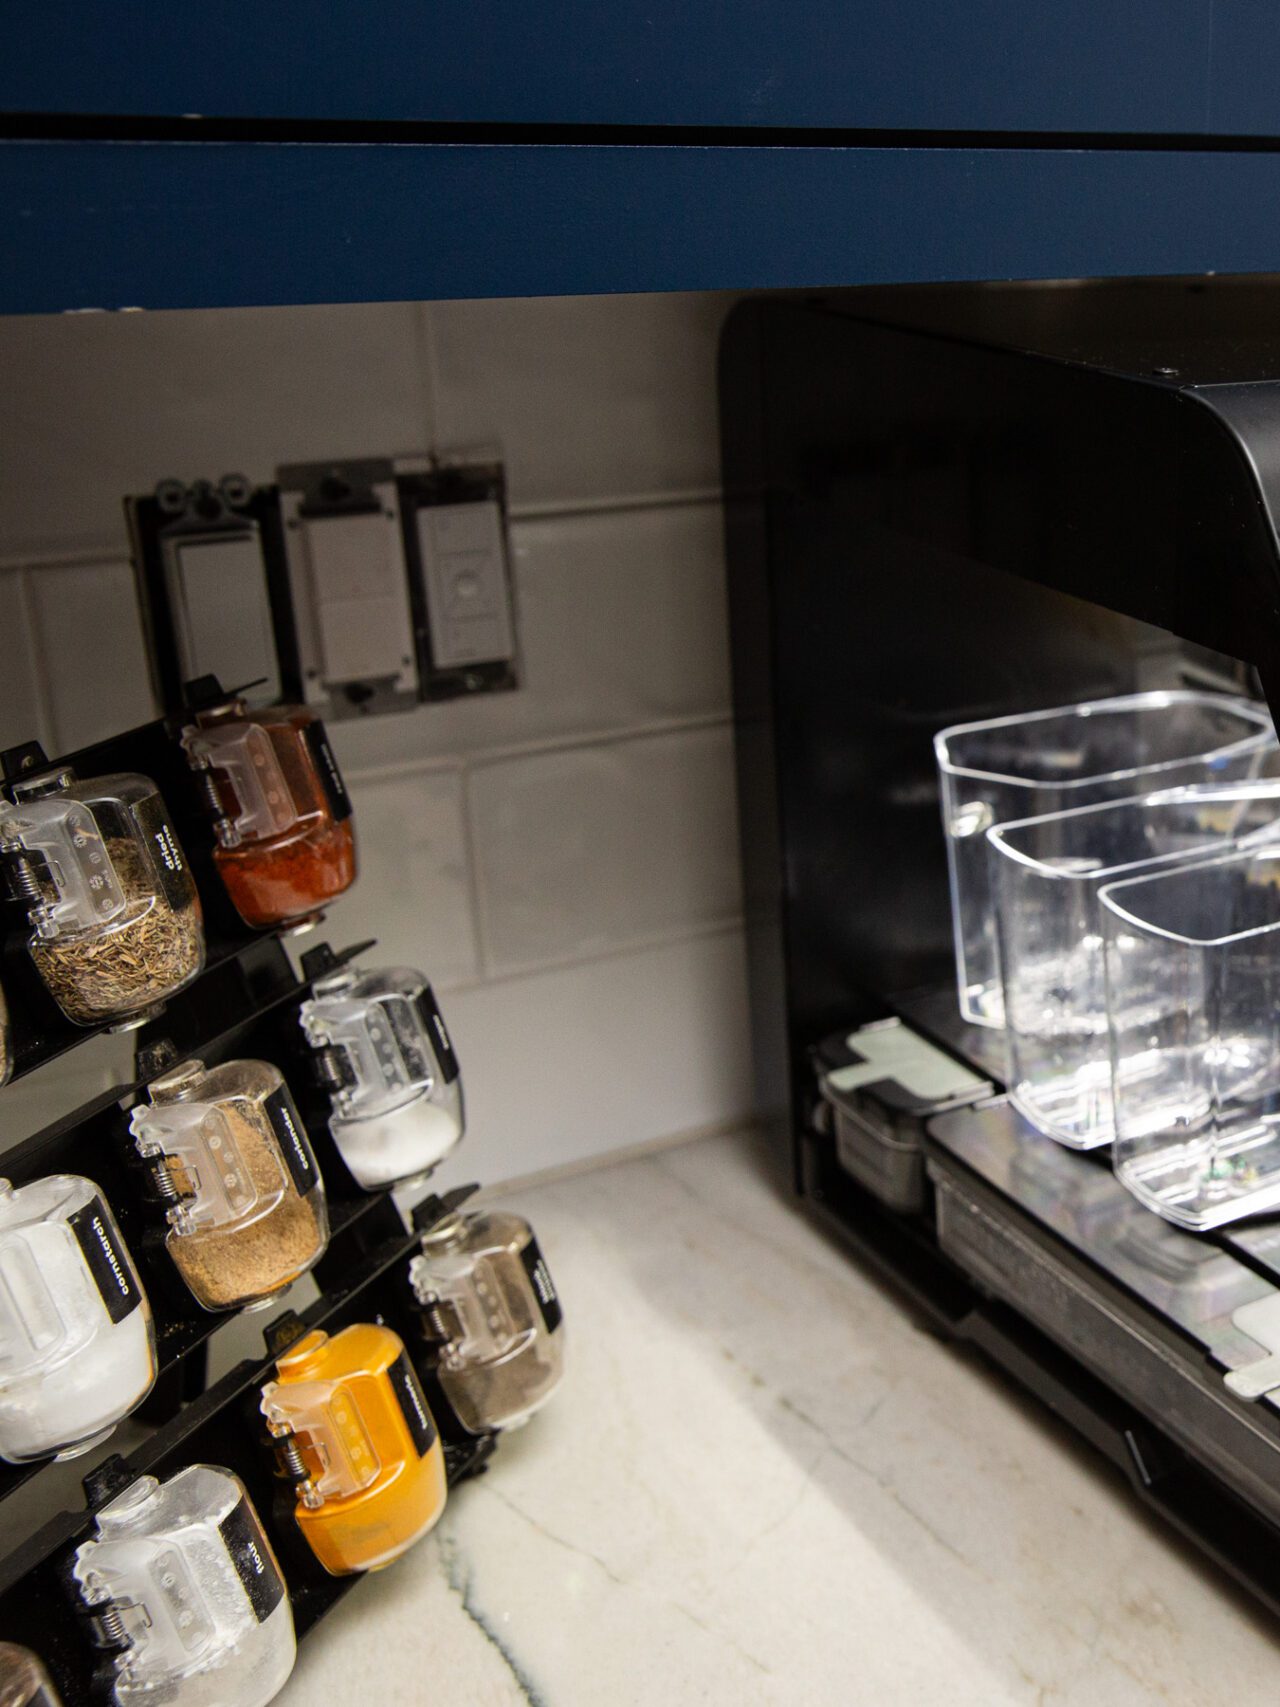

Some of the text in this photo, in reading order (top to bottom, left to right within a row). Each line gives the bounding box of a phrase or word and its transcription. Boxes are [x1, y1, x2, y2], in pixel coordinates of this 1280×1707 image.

[155, 832, 175, 870] dried
[162, 824, 182, 871] thyme
[280, 1106, 309, 1170] coriander
[92, 1215, 130, 1297] cornstarch
[247, 1541, 265, 1574] flour
